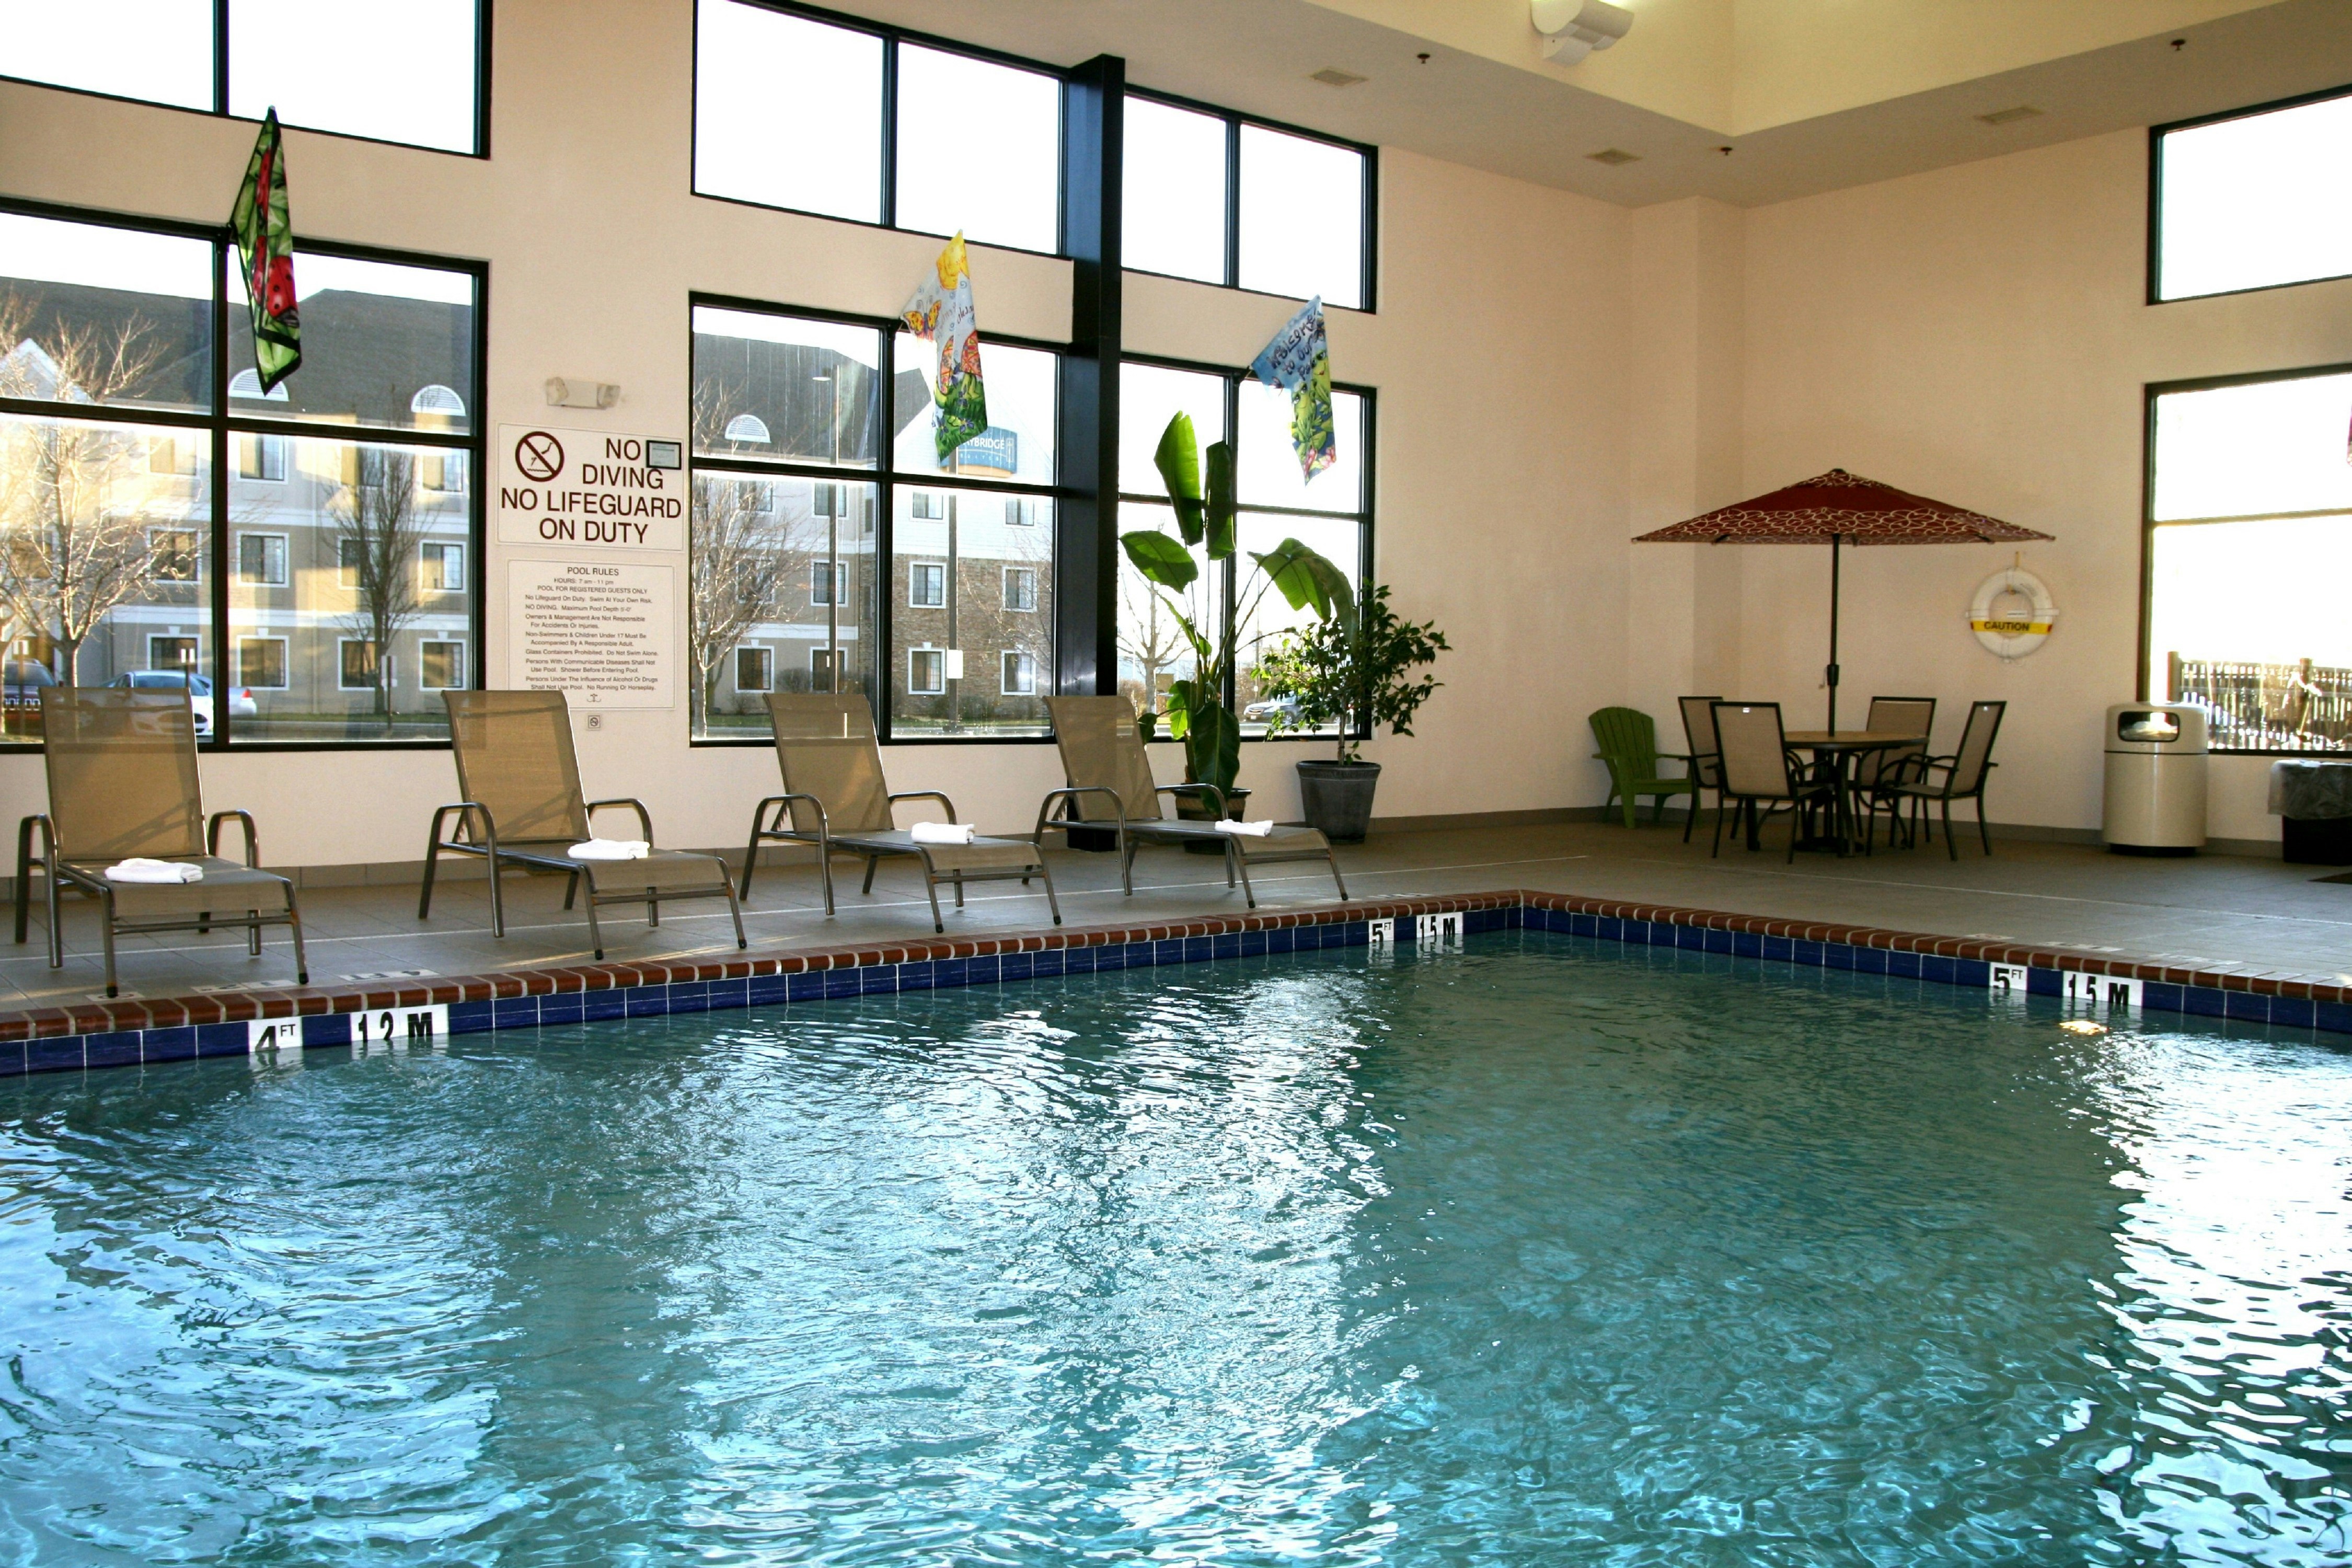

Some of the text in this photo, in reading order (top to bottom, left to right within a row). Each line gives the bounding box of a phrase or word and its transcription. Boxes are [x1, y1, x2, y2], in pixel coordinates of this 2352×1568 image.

[606, 438, 641, 461] NO
[963, 437, 1005, 449] YBRIDGE
[582, 464, 663, 489] DIVING
[502, 488, 682, 518] NO LIFEGUARD
[539, 517, 649, 544] ON DUTY
[1984, 621, 2030, 631] CAUTION
